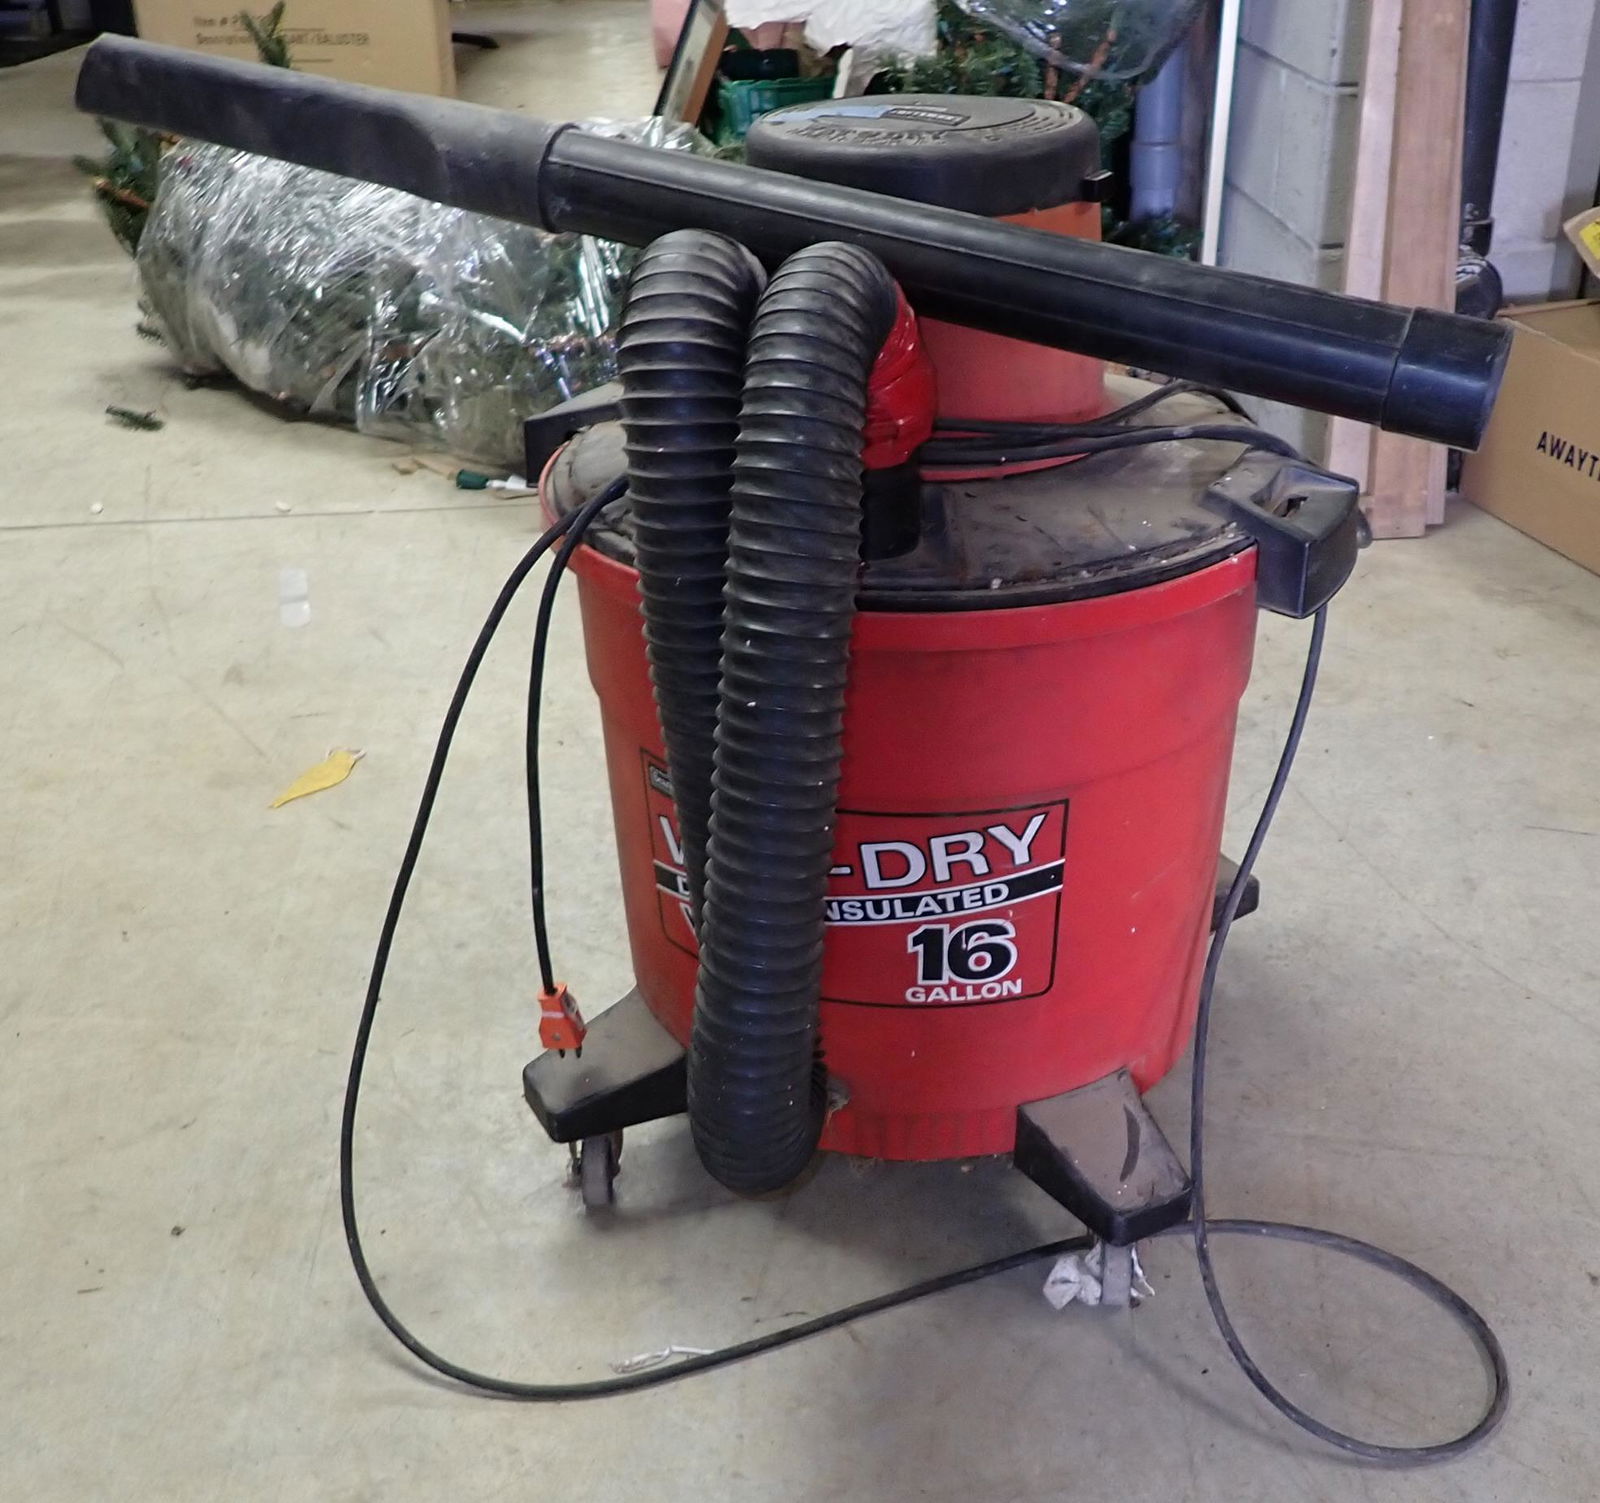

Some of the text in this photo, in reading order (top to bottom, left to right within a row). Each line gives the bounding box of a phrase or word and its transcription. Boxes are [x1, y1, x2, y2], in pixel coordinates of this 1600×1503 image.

[1536, 431, 1600, 482] AWAYT
[825, 882, 1010, 922] NSULATED
[906, 918, 1018, 985] 16
[905, 968, 1023, 1003] GALLON
